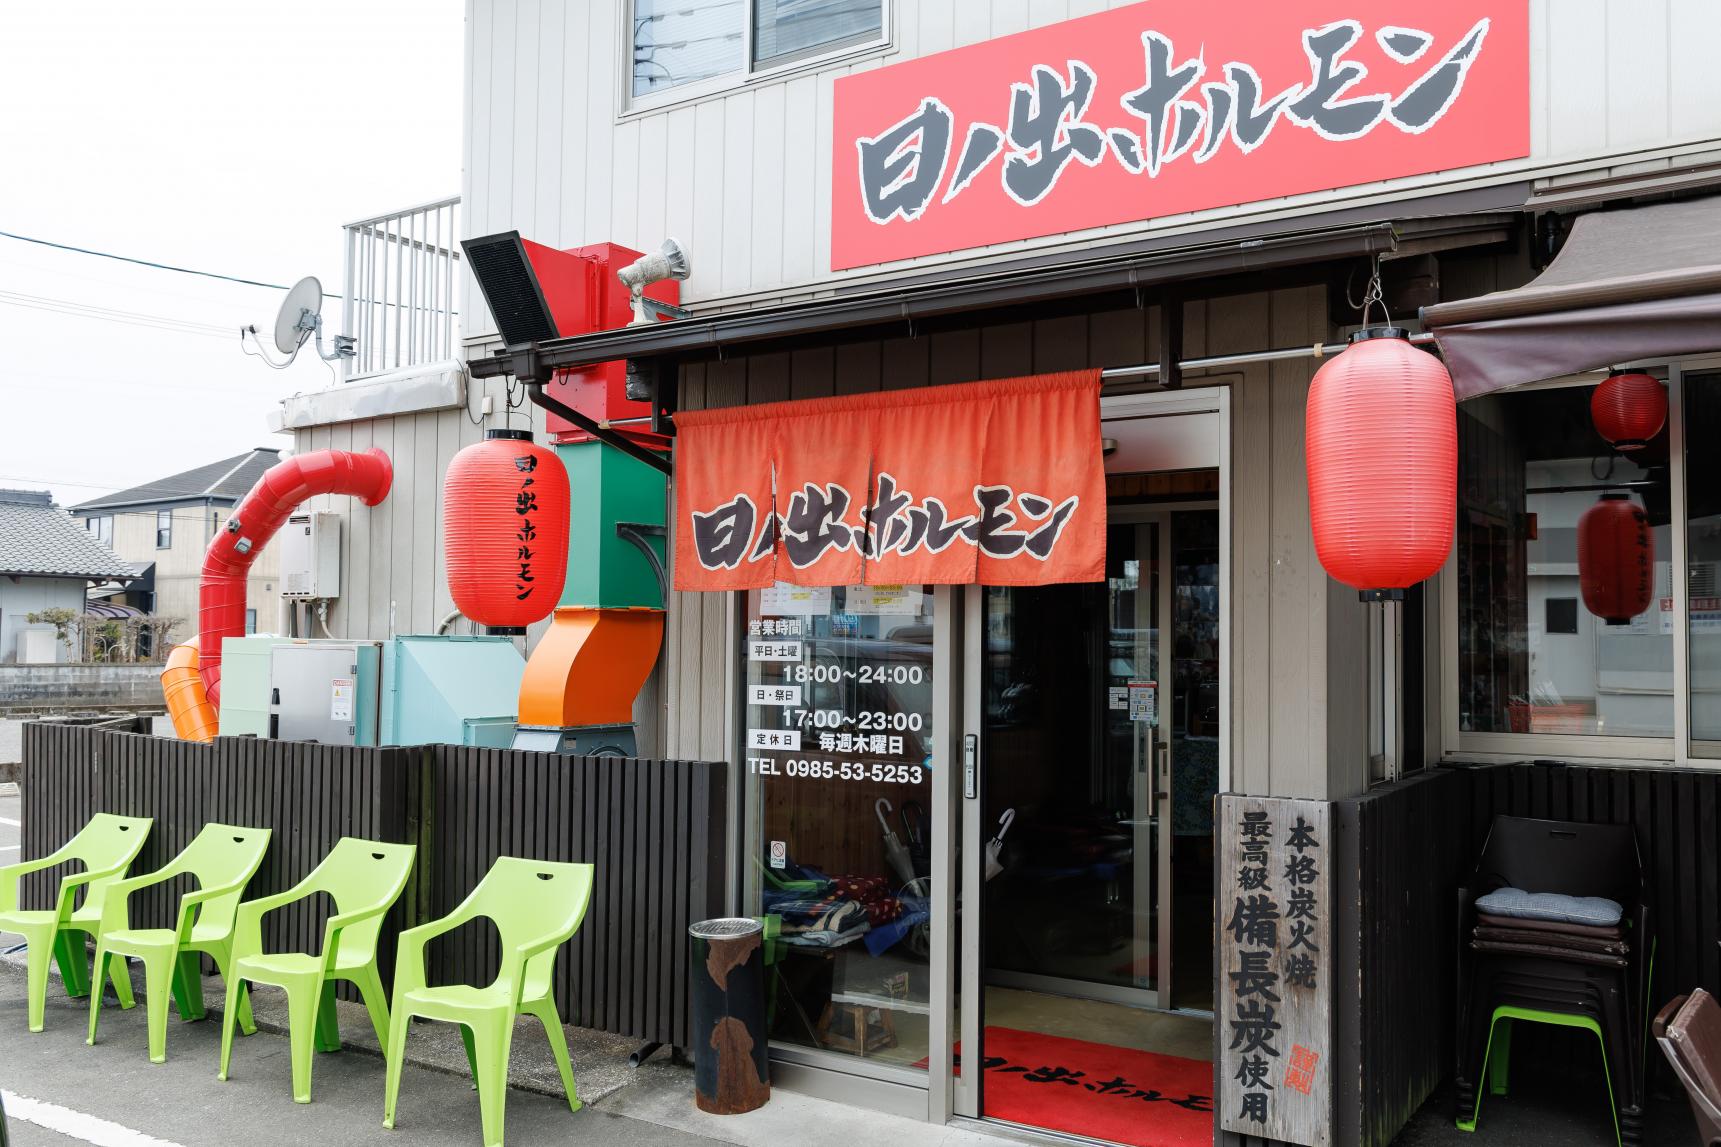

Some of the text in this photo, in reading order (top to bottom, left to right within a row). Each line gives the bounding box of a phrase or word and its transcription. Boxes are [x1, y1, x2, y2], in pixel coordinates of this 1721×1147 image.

[856, 18, 1491, 225] 日ノ出ホルモン
[515, 454, 538, 601] 日ノ出ホルモン
[692, 472, 1079, 570] 日ノ出ホルモン
[750, 619, 801, 636] 営業時間
[754, 645, 798, 657] 平日・土曜
[748, 757, 923, 784] TEL 0985-53-5253
[756, 734, 792, 746] 定休日
[819, 733, 903, 755] 毎週木曜日
[1283, 817, 1321, 989] 本格炭火焼
[1226, 811, 1282, 1125] 最高級備長炭使用
